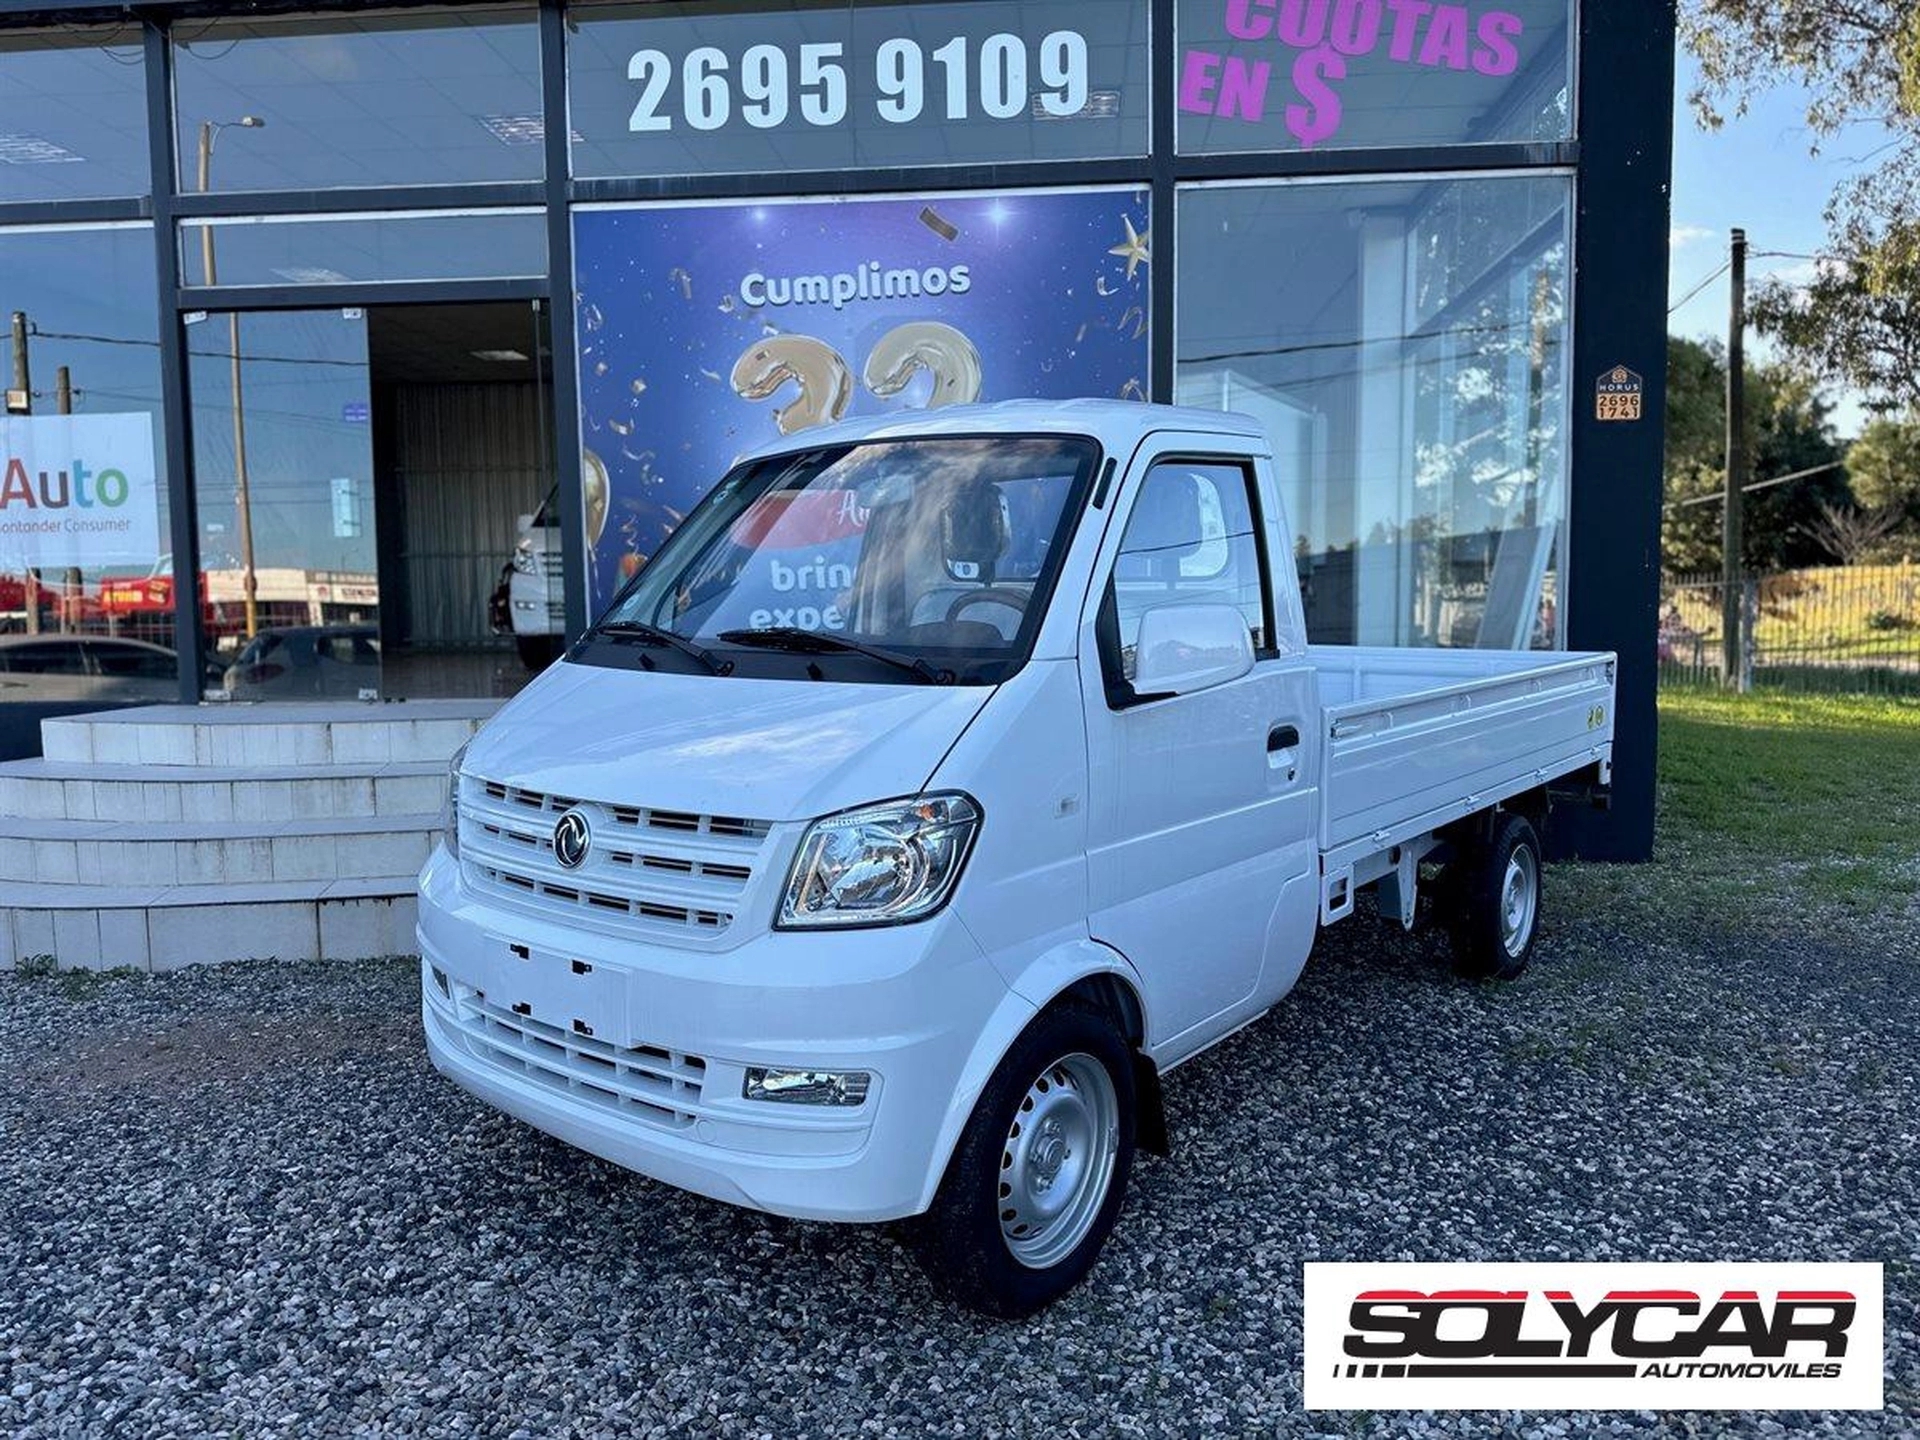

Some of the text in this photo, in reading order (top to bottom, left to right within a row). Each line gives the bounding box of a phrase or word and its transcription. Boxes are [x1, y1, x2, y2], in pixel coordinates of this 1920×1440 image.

[1225, 0, 1523, 76] CUOTAS
[627, 30, 1088, 132] 2695 9109
[1179, 44, 1347, 151] EN $
[740, 261, 971, 309] Cumplimos
[1599, 383, 1640, 392] HORUS
[1599, 395, 1640, 407] 2696
[1599, 407, 1639, 418] 1741
[0, 458, 129, 509] Auto
[64, 519, 130, 533] Consumer
[770, 555, 857, 592] brin
